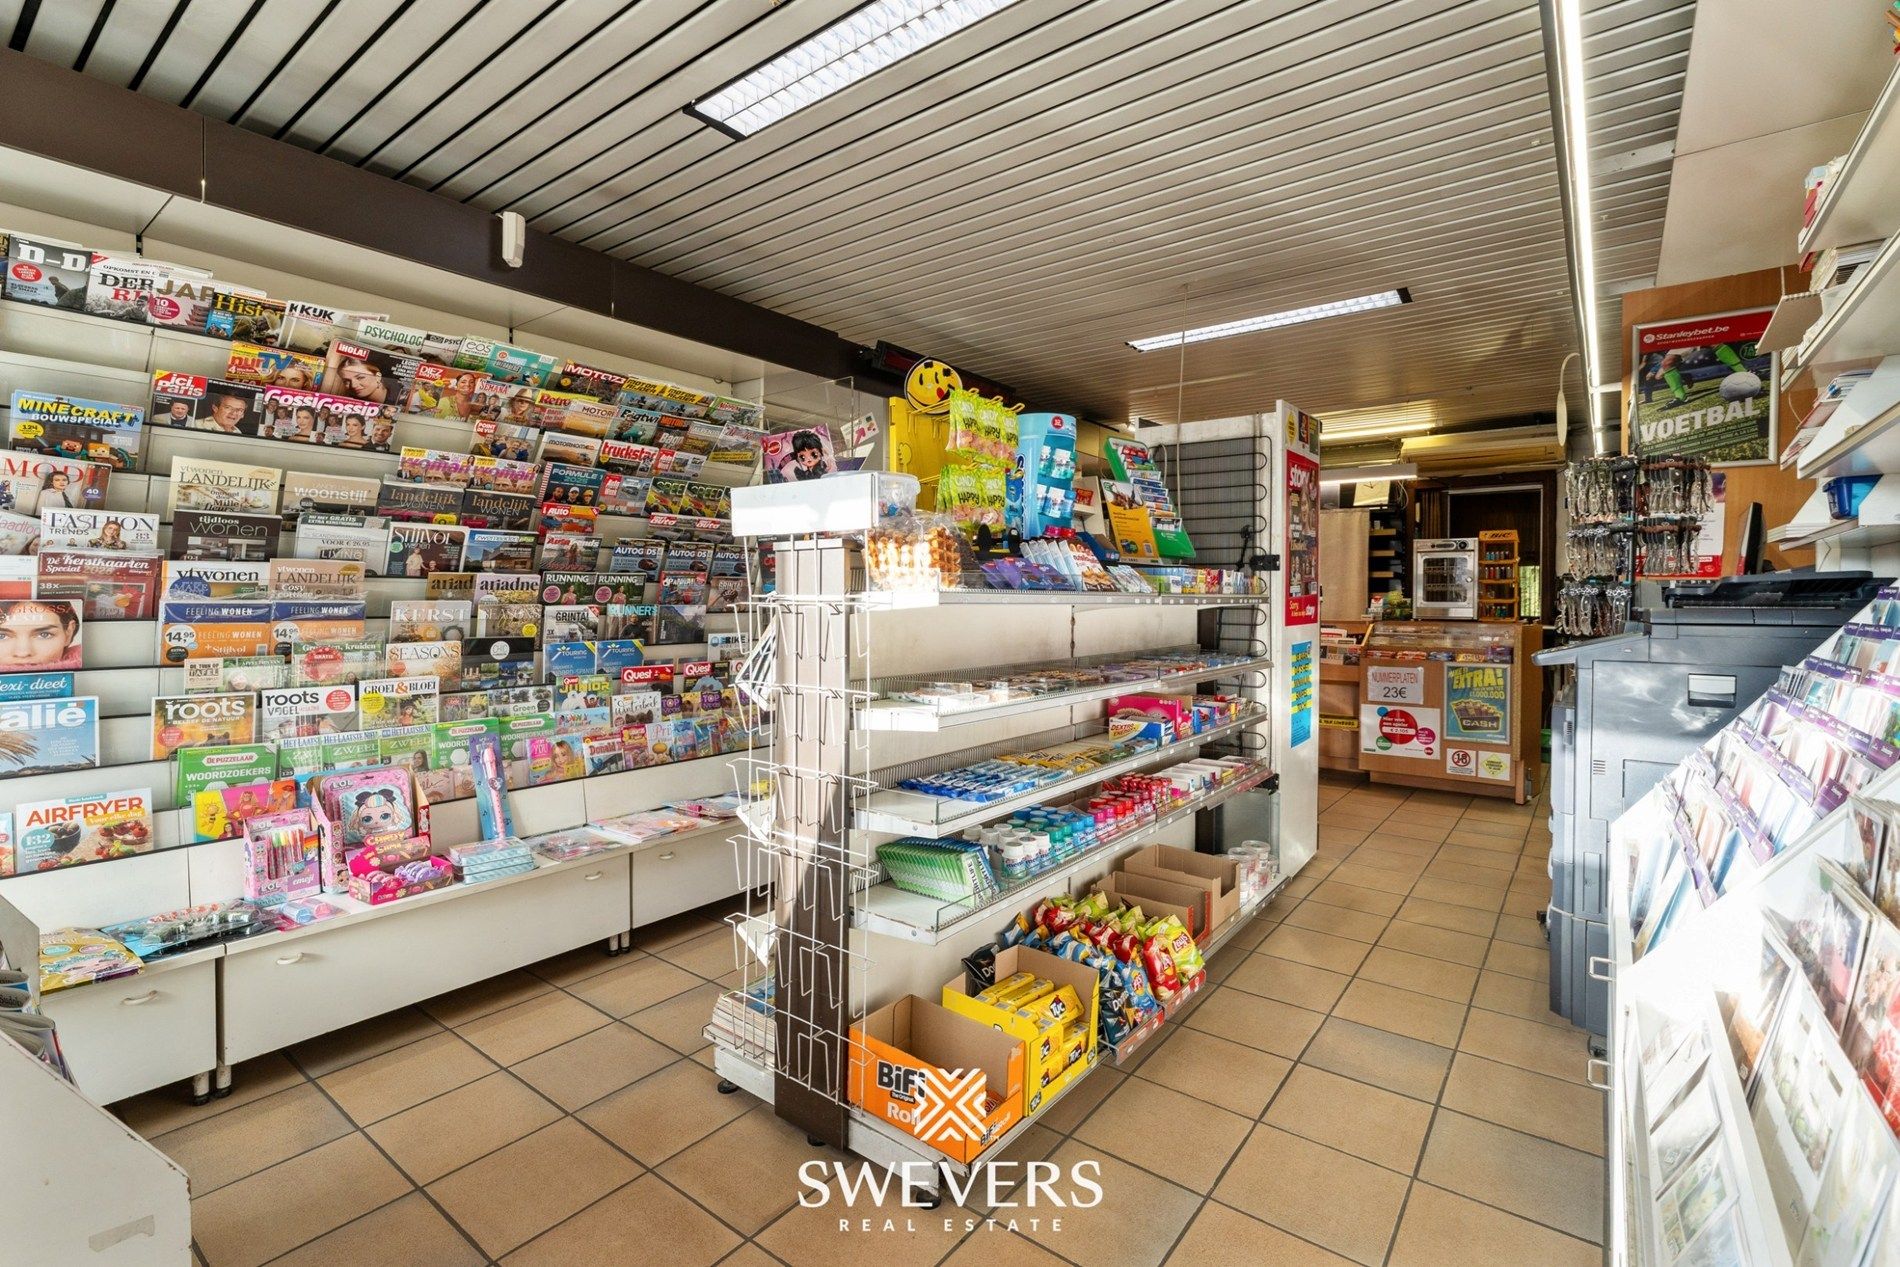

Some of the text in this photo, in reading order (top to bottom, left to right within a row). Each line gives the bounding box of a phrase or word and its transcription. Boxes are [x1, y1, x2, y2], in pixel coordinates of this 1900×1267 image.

[18, 243, 89, 272] D-D
[300, 306, 335, 321] KIJK
[364, 325, 424, 347] PSYCHOLOG
[1655, 325, 1730, 342] Stanleybet.be
[156, 378, 203, 397] Paris
[626, 379, 657, 390] MOTOR
[668, 388, 696, 399] MOTOR
[18, 398, 138, 424] MINECRAFT
[316, 396, 380, 418] Gossip
[31, 413, 120, 426] BOUWSPECIAL
[1640, 397, 1761, 443] VOETBAL
[552, 468, 598, 479] FORMULE
[179, 471, 270, 491] LANDELIJK
[294, 486, 368, 503] woonstijl
[390, 488, 456, 505] landelijk
[401, 501, 445, 511] WONEN
[473, 496, 530, 511] landelijk
[480, 506, 520, 517] WONEN
[0, 520, 41, 536] aadloo
[49, 527, 90, 536] TRENDS
[190, 521, 268, 537] wonen
[62, 553, 150, 569] Kerstkaarten
[45, 564, 81, 574] Special
[177, 567, 260, 582] vtwonen
[277, 565, 315, 573] vtwonen
[276, 573, 357, 587] LANDELIJK
[480, 577, 539, 591] ariadne
[546, 574, 590, 583] RUNNING
[599, 575, 638, 584] RUNNING
[185, 607, 253, 615] FEELING WONEN
[395, 608, 467, 622] KERST
[555, 611, 590, 622] GRINTA!
[232, 631, 262, 640] WONEN
[388, 644, 461, 660] SEASONS
[623, 669, 652, 682] Quest
[686, 663, 711, 676] Quest
[0, 677, 67, 692] exi-dieet
[1371, 672, 1418, 684] NUMMERPLATEN
[364, 681, 436, 695] GROEI & BLOEI
[559, 682, 610, 694] JUNIOR
[1383, 687, 1407, 698] 23€
[265, 691, 320, 707] roots
[165, 700, 246, 720] roots
[1462, 719, 1498, 728] CASH
[186, 766, 272, 782] WOORDZOEKERS
[26, 797, 144, 827] AIRFRYER
[26, 834, 51, 846] 132
